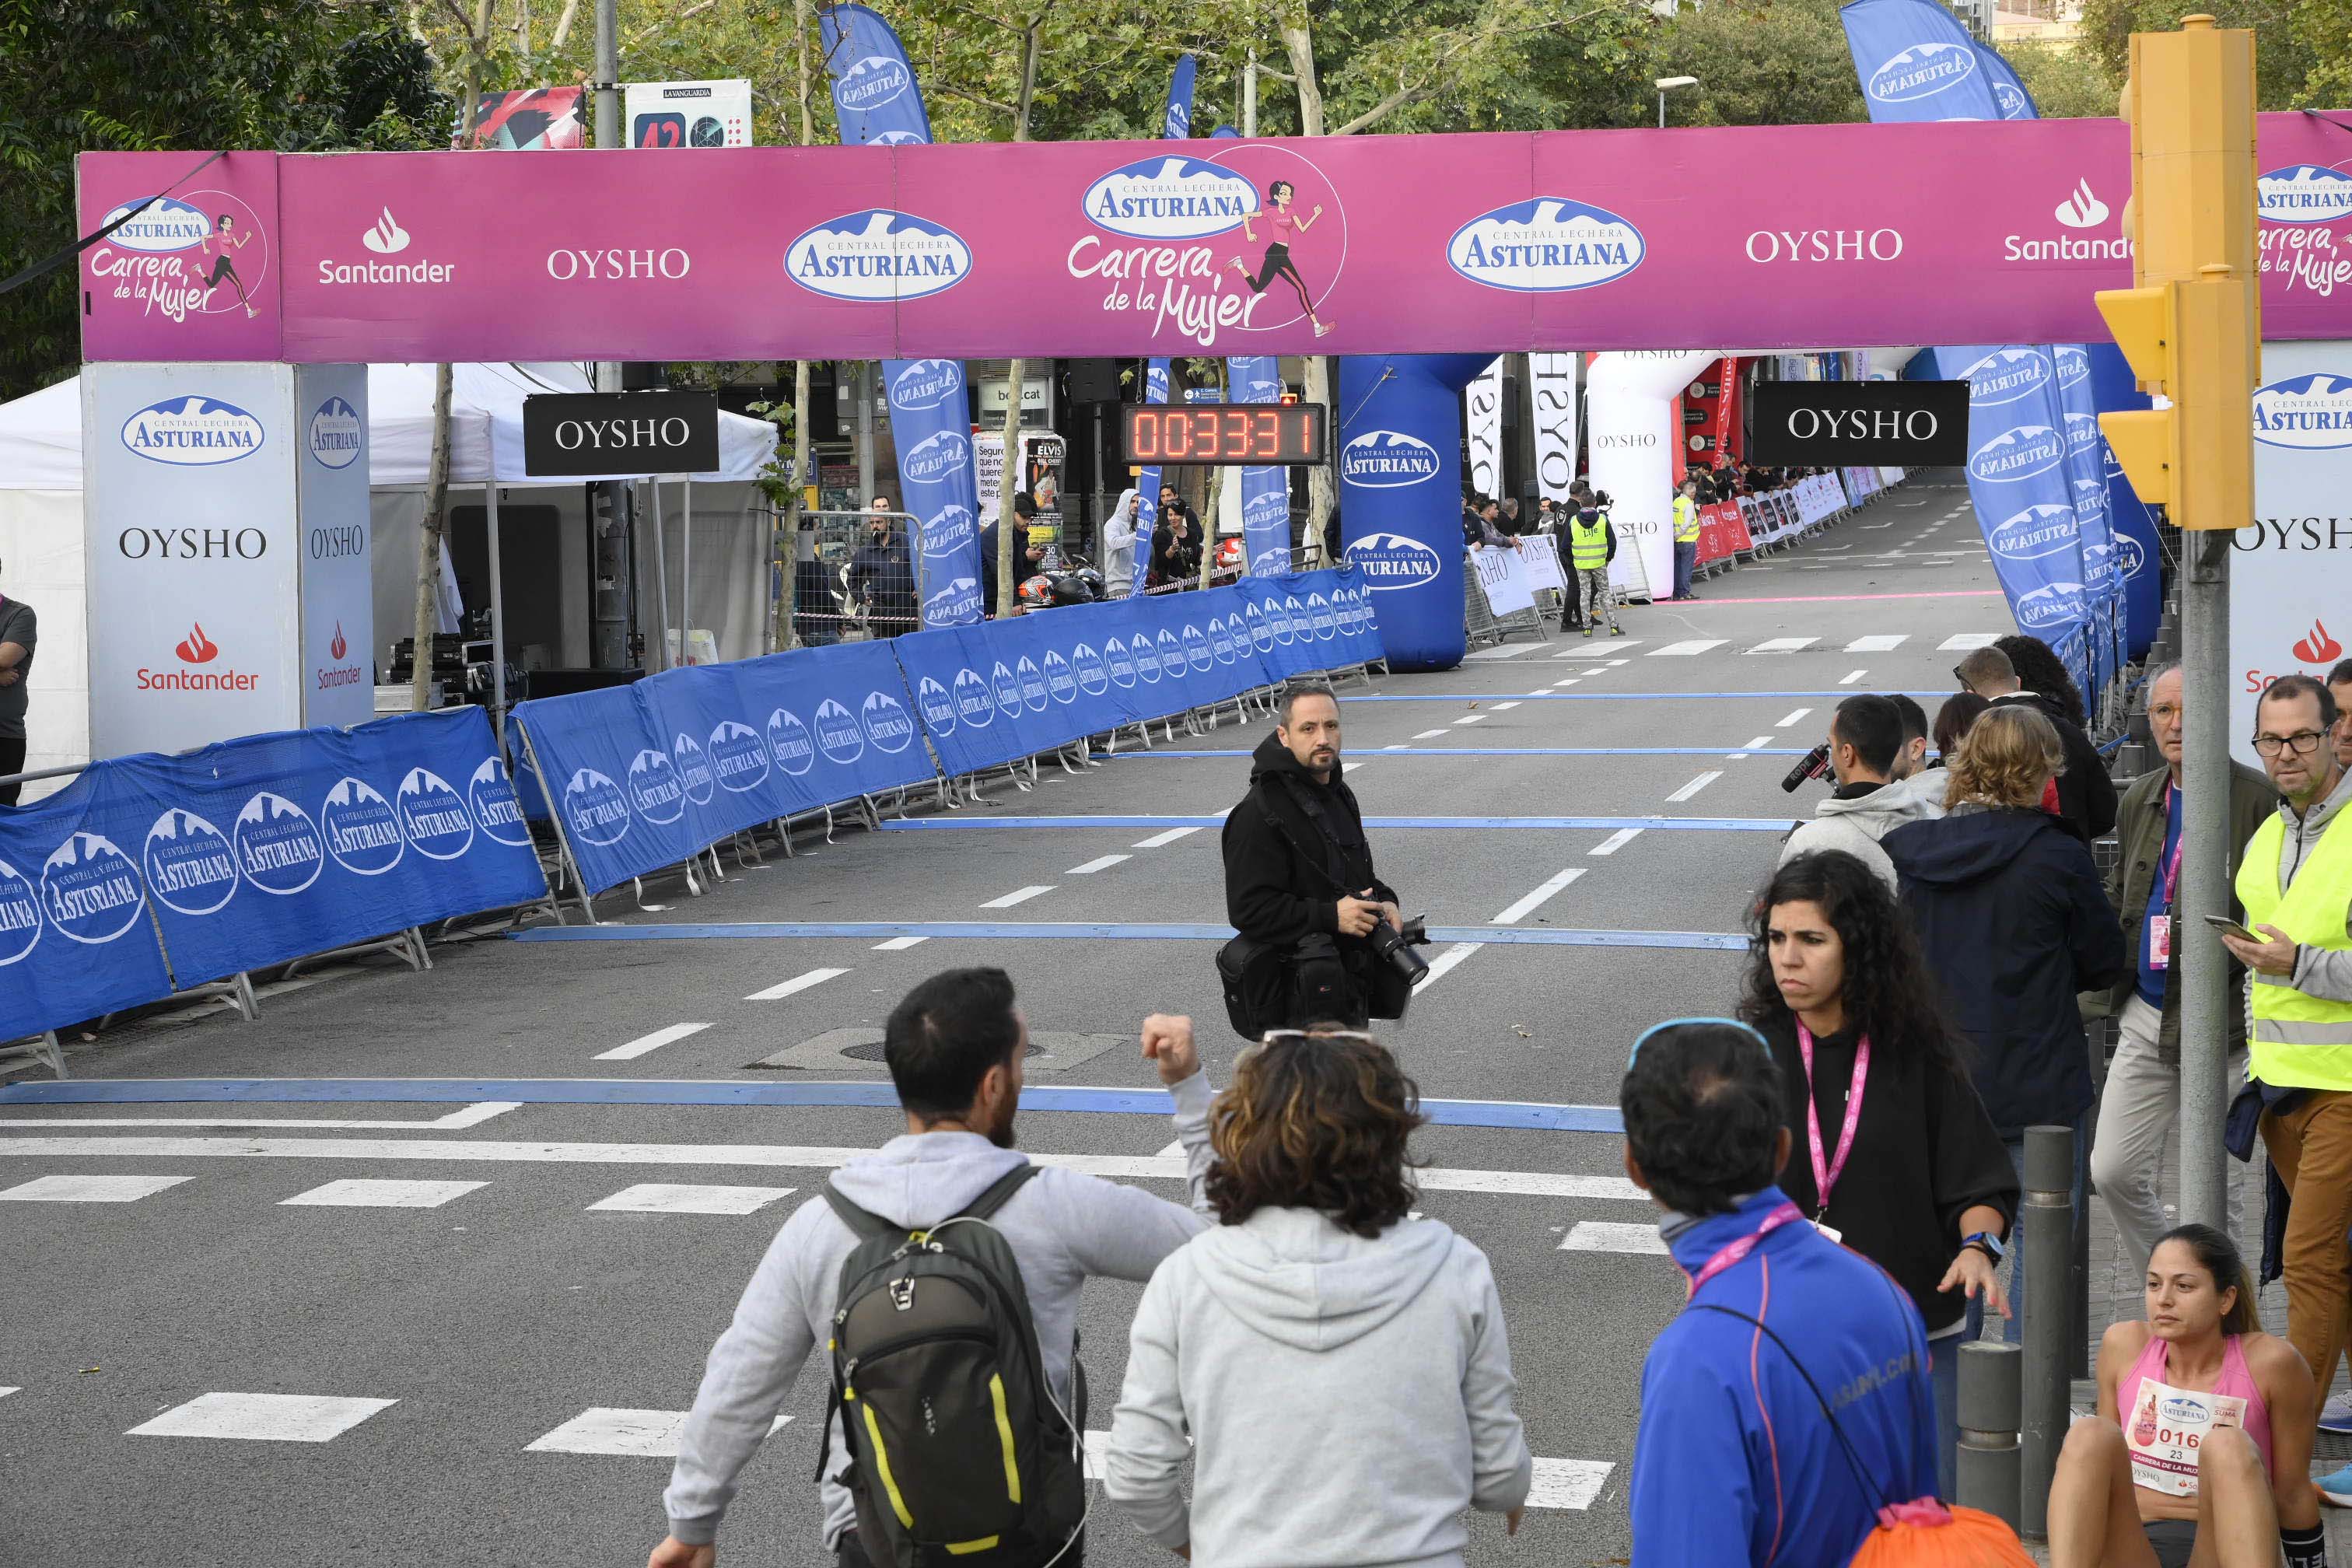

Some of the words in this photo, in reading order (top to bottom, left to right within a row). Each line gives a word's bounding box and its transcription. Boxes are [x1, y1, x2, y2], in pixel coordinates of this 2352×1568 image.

[1123, 184, 1178, 193] CENTRAL
[1185, 183, 1241, 192] LECHERA
[1096, 187, 1246, 219] ASTURIANA
[828, 241, 887, 250] CENTRAL
[1493, 231, 1553, 240] CENTRAL
[1561, 229, 1623, 237] LECHERA
[1745, 229, 1903, 264] OYSHO
[2005, 234, 2134, 261] Santand
[2258, 227, 2332, 250] arrera
[91, 247, 183, 278] Carrera
[799, 243, 957, 278] ASTURIANA
[1068, 235, 1213, 278] Carrera
[1462, 233, 1630, 268] ASTURIANA
[320, 258, 454, 284] Santander
[547, 248, 691, 280] OYSHO
[2276, 250, 2290, 272] la
[2285, 245, 2352, 297] Muje
[114, 278, 131, 299] de
[135, 278, 147, 299] la
[145, 275, 219, 324] Mujer
[1103, 280, 1130, 311] de
[1136, 279, 1157, 310] la
[1151, 272, 1269, 347] Mujer
[2273, 400, 2327, 408] CENTRAL
[155, 419, 198, 428] CENTRAL
[1788, 408, 1937, 442] OYSHO
[2253, 403, 2352, 432] ASTURIA
[133, 421, 254, 448] ASTURIANA
[313, 424, 359, 451] ASTURIANA
[555, 417, 690, 450] OYSHO
[1135, 412, 1310, 456] 00:33:31
[1598, 433, 1657, 449] OYSHO
[1038, 445, 1062, 456] ELVIS
[980, 468, 1004, 477] quiere
[1345, 453, 1432, 475] ASTURIANA
[119, 528, 267, 559] OYSHO
[311, 525, 363, 560] OYSHO
[1584, 526, 1598, 537] Life
[2231, 516, 2352, 552] OYSH
[1045, 546, 1055, 555] 30
[138, 668, 259, 691] Santander
[317, 666, 361, 690] Santander
[818, 726, 862, 750] ASTURIANA
[483, 787, 509, 798] CENTRAL
[337, 811, 364, 823] CENTRAL
[404, 804, 470, 840] ASTURIANA
[476, 793, 523, 828] ASTUR
[250, 828, 278, 841] CENTRAL
[279, 821, 308, 835] LECHERA
[330, 817, 401, 855] ASTURIANA
[162, 845, 194, 859] CENTRAL
[194, 839, 222, 853] LECHERA
[242, 835, 320, 874] ASTURIANA
[59, 871, 93, 886] CENTRAL
[154, 852, 234, 894] ASTURIANA
[2214, 1409, 2236, 1418] SUMA
[2159, 1428, 2200, 1449] 016
[2133, 1454, 2161, 1468] CARRERA
[2161, 1461, 2172, 1470] DE
[2169, 1449, 2182, 1460] 23
